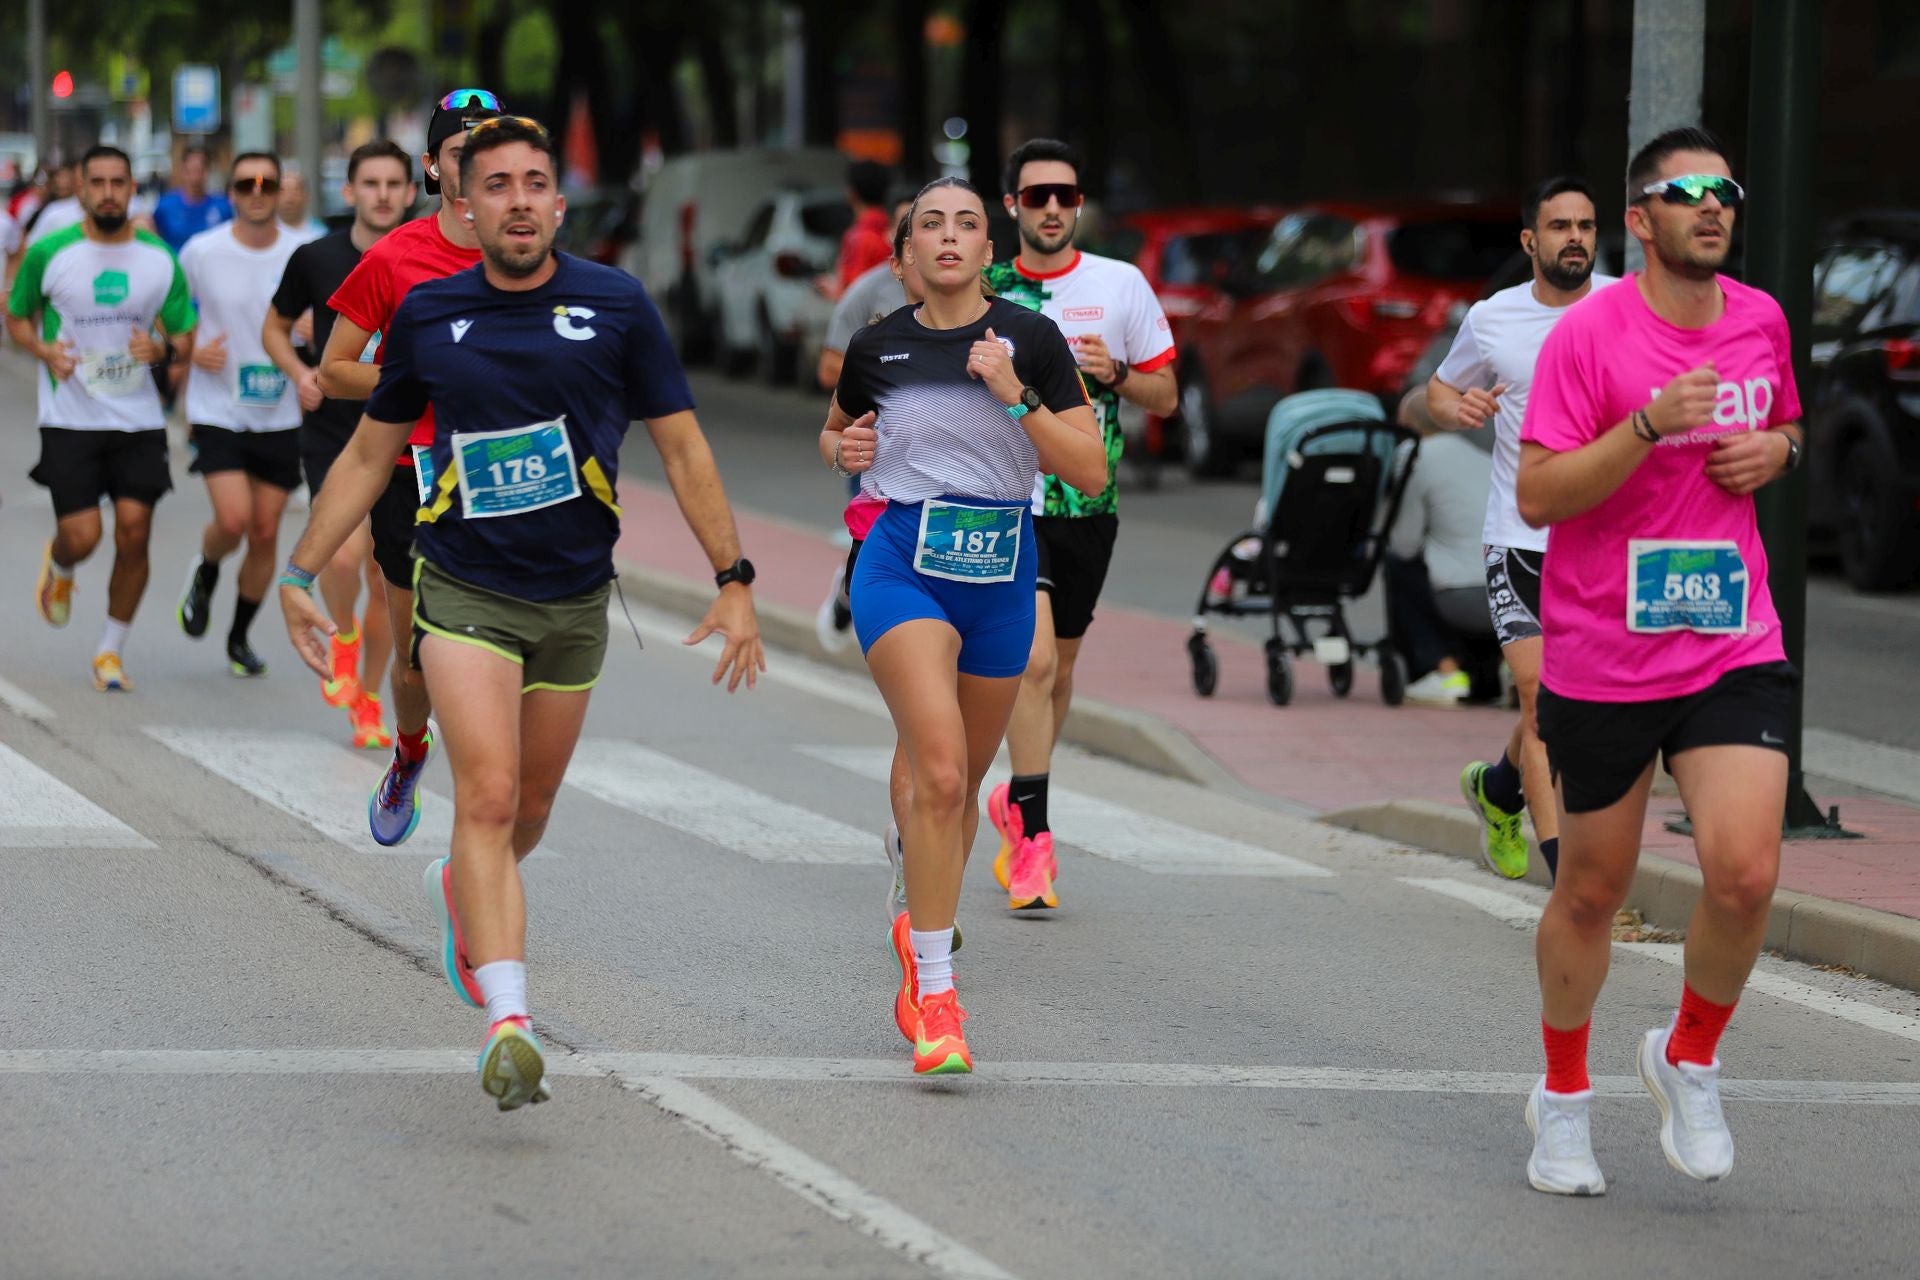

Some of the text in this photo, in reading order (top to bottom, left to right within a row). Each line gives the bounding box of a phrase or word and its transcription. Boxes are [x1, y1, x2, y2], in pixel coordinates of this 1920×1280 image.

[488, 455, 547, 486] 178
[952, 530, 1000, 553] 187
[1663, 573, 1721, 601] 563
